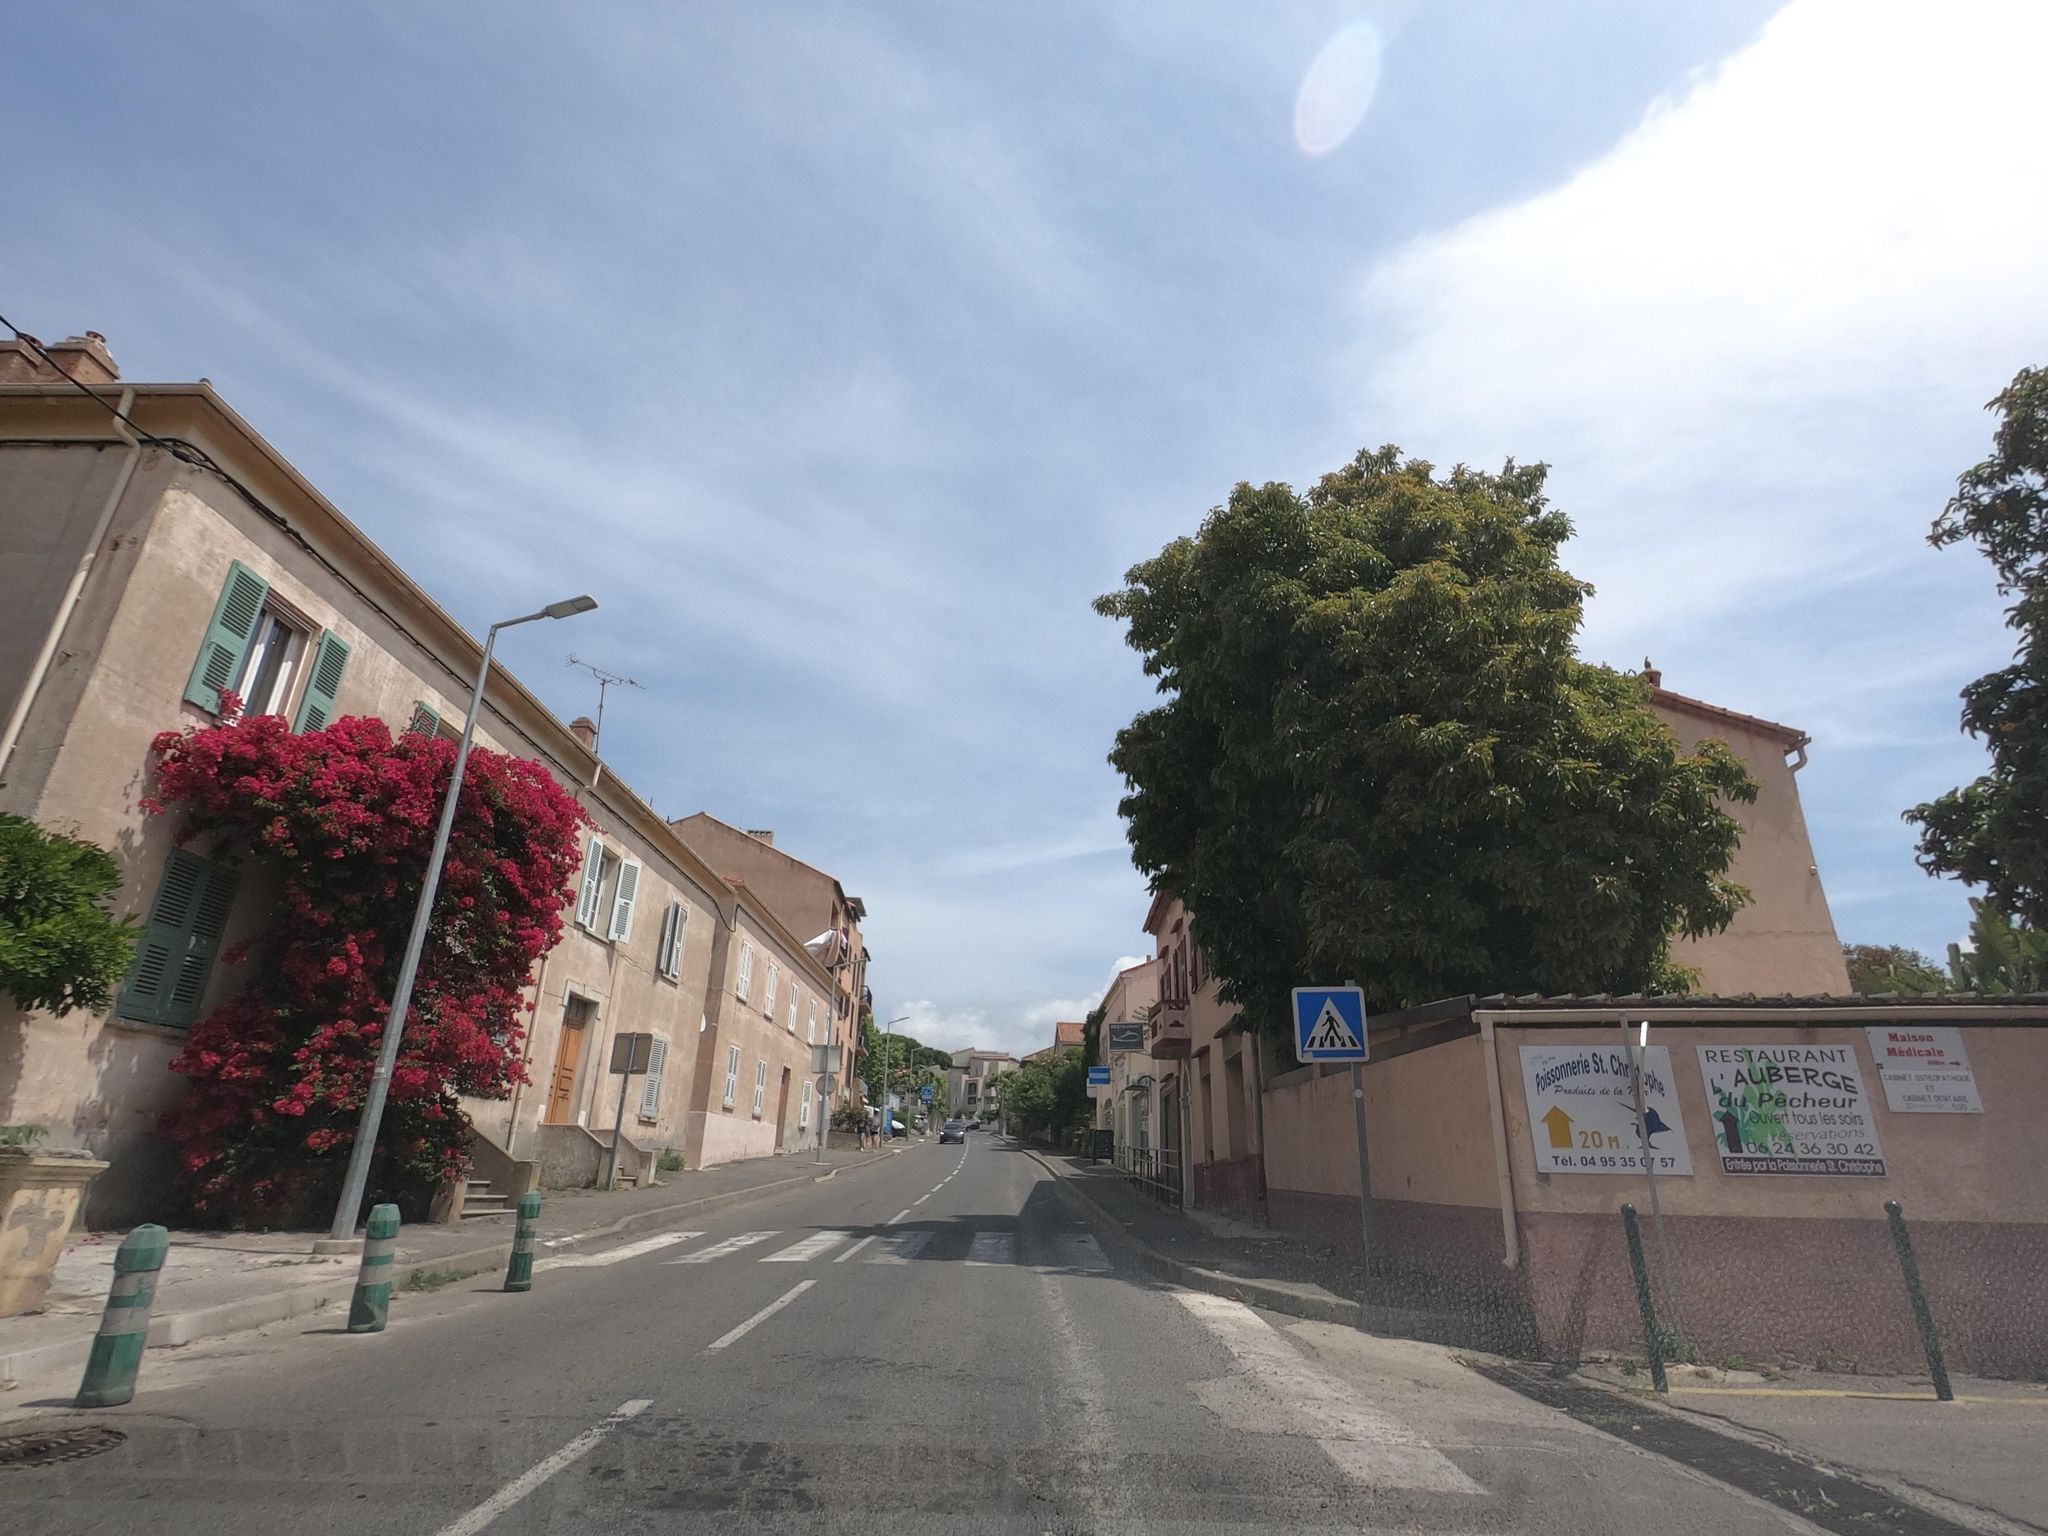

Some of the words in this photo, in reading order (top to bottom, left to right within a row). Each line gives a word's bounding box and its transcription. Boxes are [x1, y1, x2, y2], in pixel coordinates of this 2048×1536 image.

[1887, 1033, 1934, 1042] Maison
[1705, 1050, 1846, 1063] RESTAURANT
[1886, 1046, 1945, 1057] Médicale
[1535, 1053, 1590, 1096] Poissonnerie
[1591, 1052, 1608, 1075] St.
[1610, 1054, 1665, 1097] Chrophe
[1554, 1084, 1596, 1096] Produits
[1600, 1085, 1610, 1096] de
[1613, 1085, 1623, 1096] la
[1718, 1092, 1747, 1108] du
[1758, 1092, 1857, 1109] Pêcheur
[1750, 1111, 1789, 1126] Ouvert
[1793, 1112, 1817, 1126] tous
[1820, 1112, 1836, 1126] les
[1838, 1112, 1864, 1126] soirs
[1578, 1131, 1603, 1148] 20
[1746, 1142, 1769, 1154] 06
[1772, 1142, 1795, 1154] 24
[1800, 1143, 1822, 1155] 36
[1827, 1143, 1849, 1155] 30
[1854, 1143, 1876, 1156] 42
[1552, 1155, 1577, 1167] Tél.
[1580, 1156, 1596, 1167] 04
[1600, 1156, 1616, 1168] 95
[1621, 1156, 1637, 1168] 35
[1660, 1157, 1676, 1168] 57
[1725, 1158, 1751, 1171] Entrée
[1754, 1161, 1768, 1174] par
[1769, 1159, 1777, 1172] la
[1777, 1159, 1826, 1173] Poissonnerie
